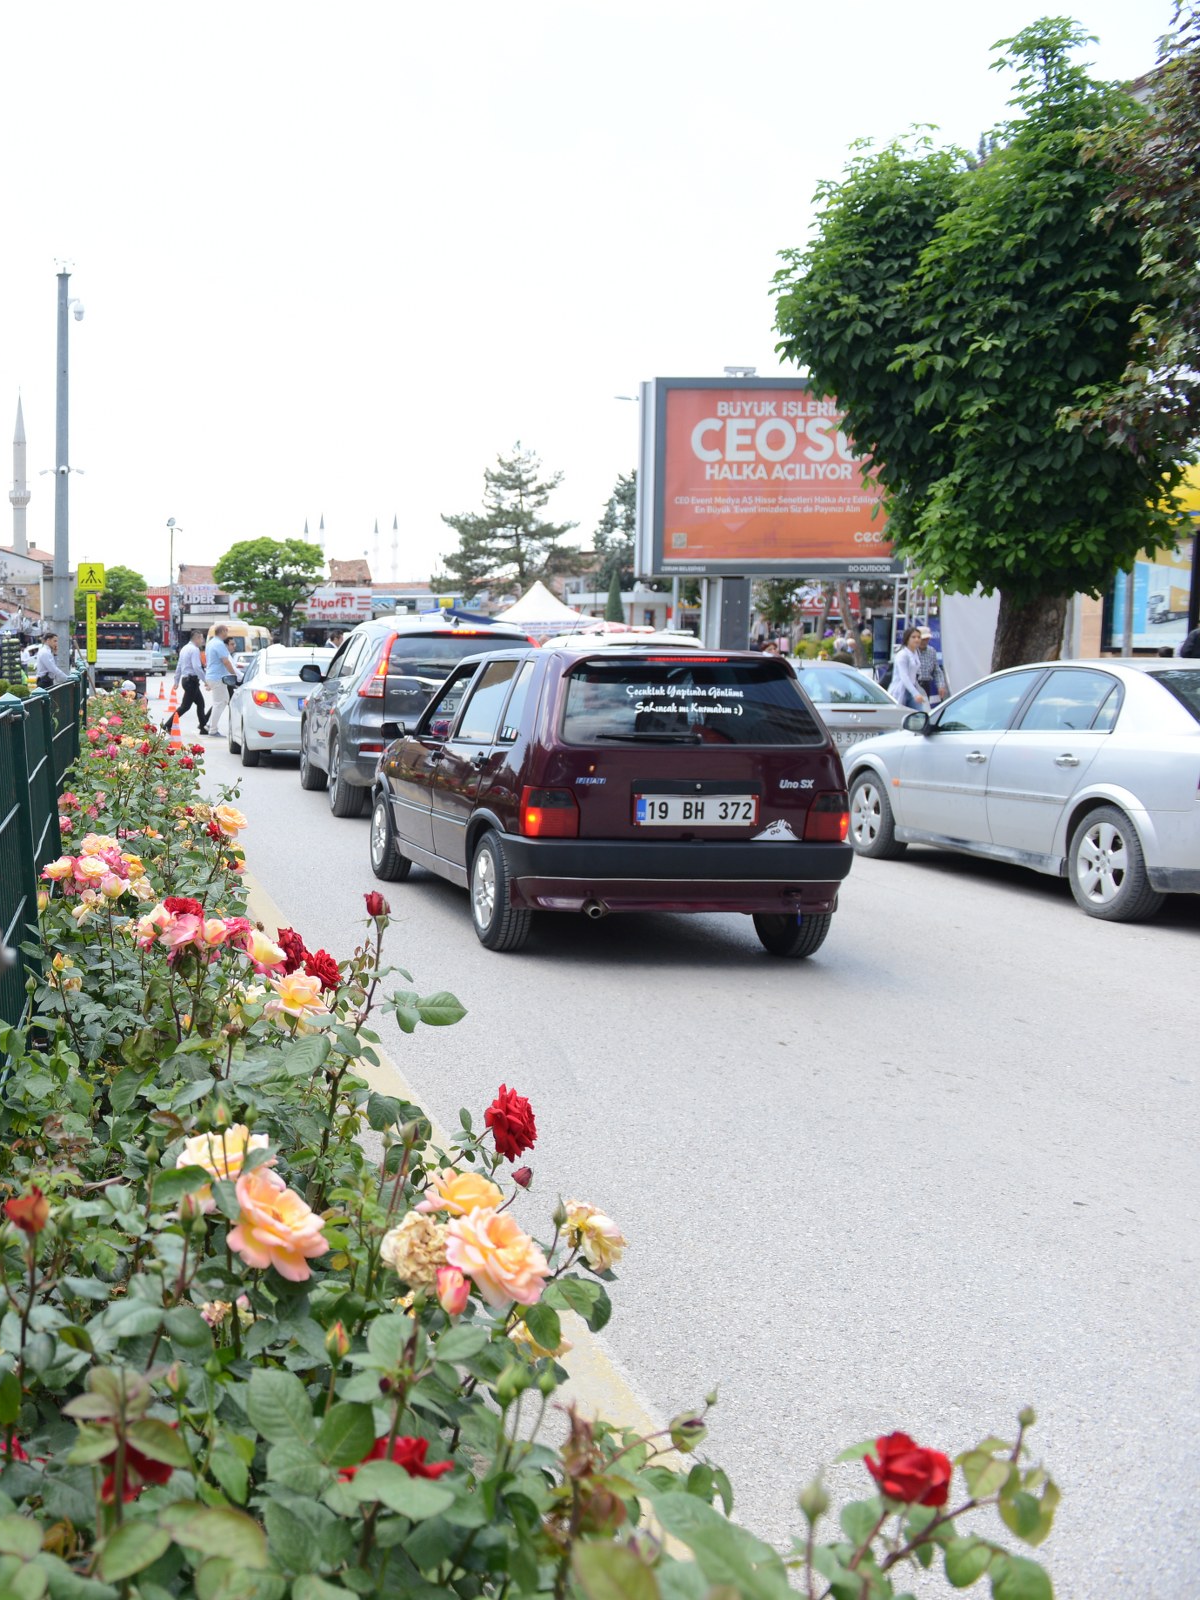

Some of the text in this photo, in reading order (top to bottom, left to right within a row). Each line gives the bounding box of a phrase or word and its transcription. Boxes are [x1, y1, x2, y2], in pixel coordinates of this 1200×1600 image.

[717, 401, 776, 417] BÜYÜK
[705, 463, 853, 481] HALKA AÇILIYOR
[852, 496, 880, 505] Ediliyo
[779, 779, 814, 789] Uno SX
[648, 801, 669, 820] 19
[682, 801, 705, 820] BH
[718, 801, 753, 820] 372
